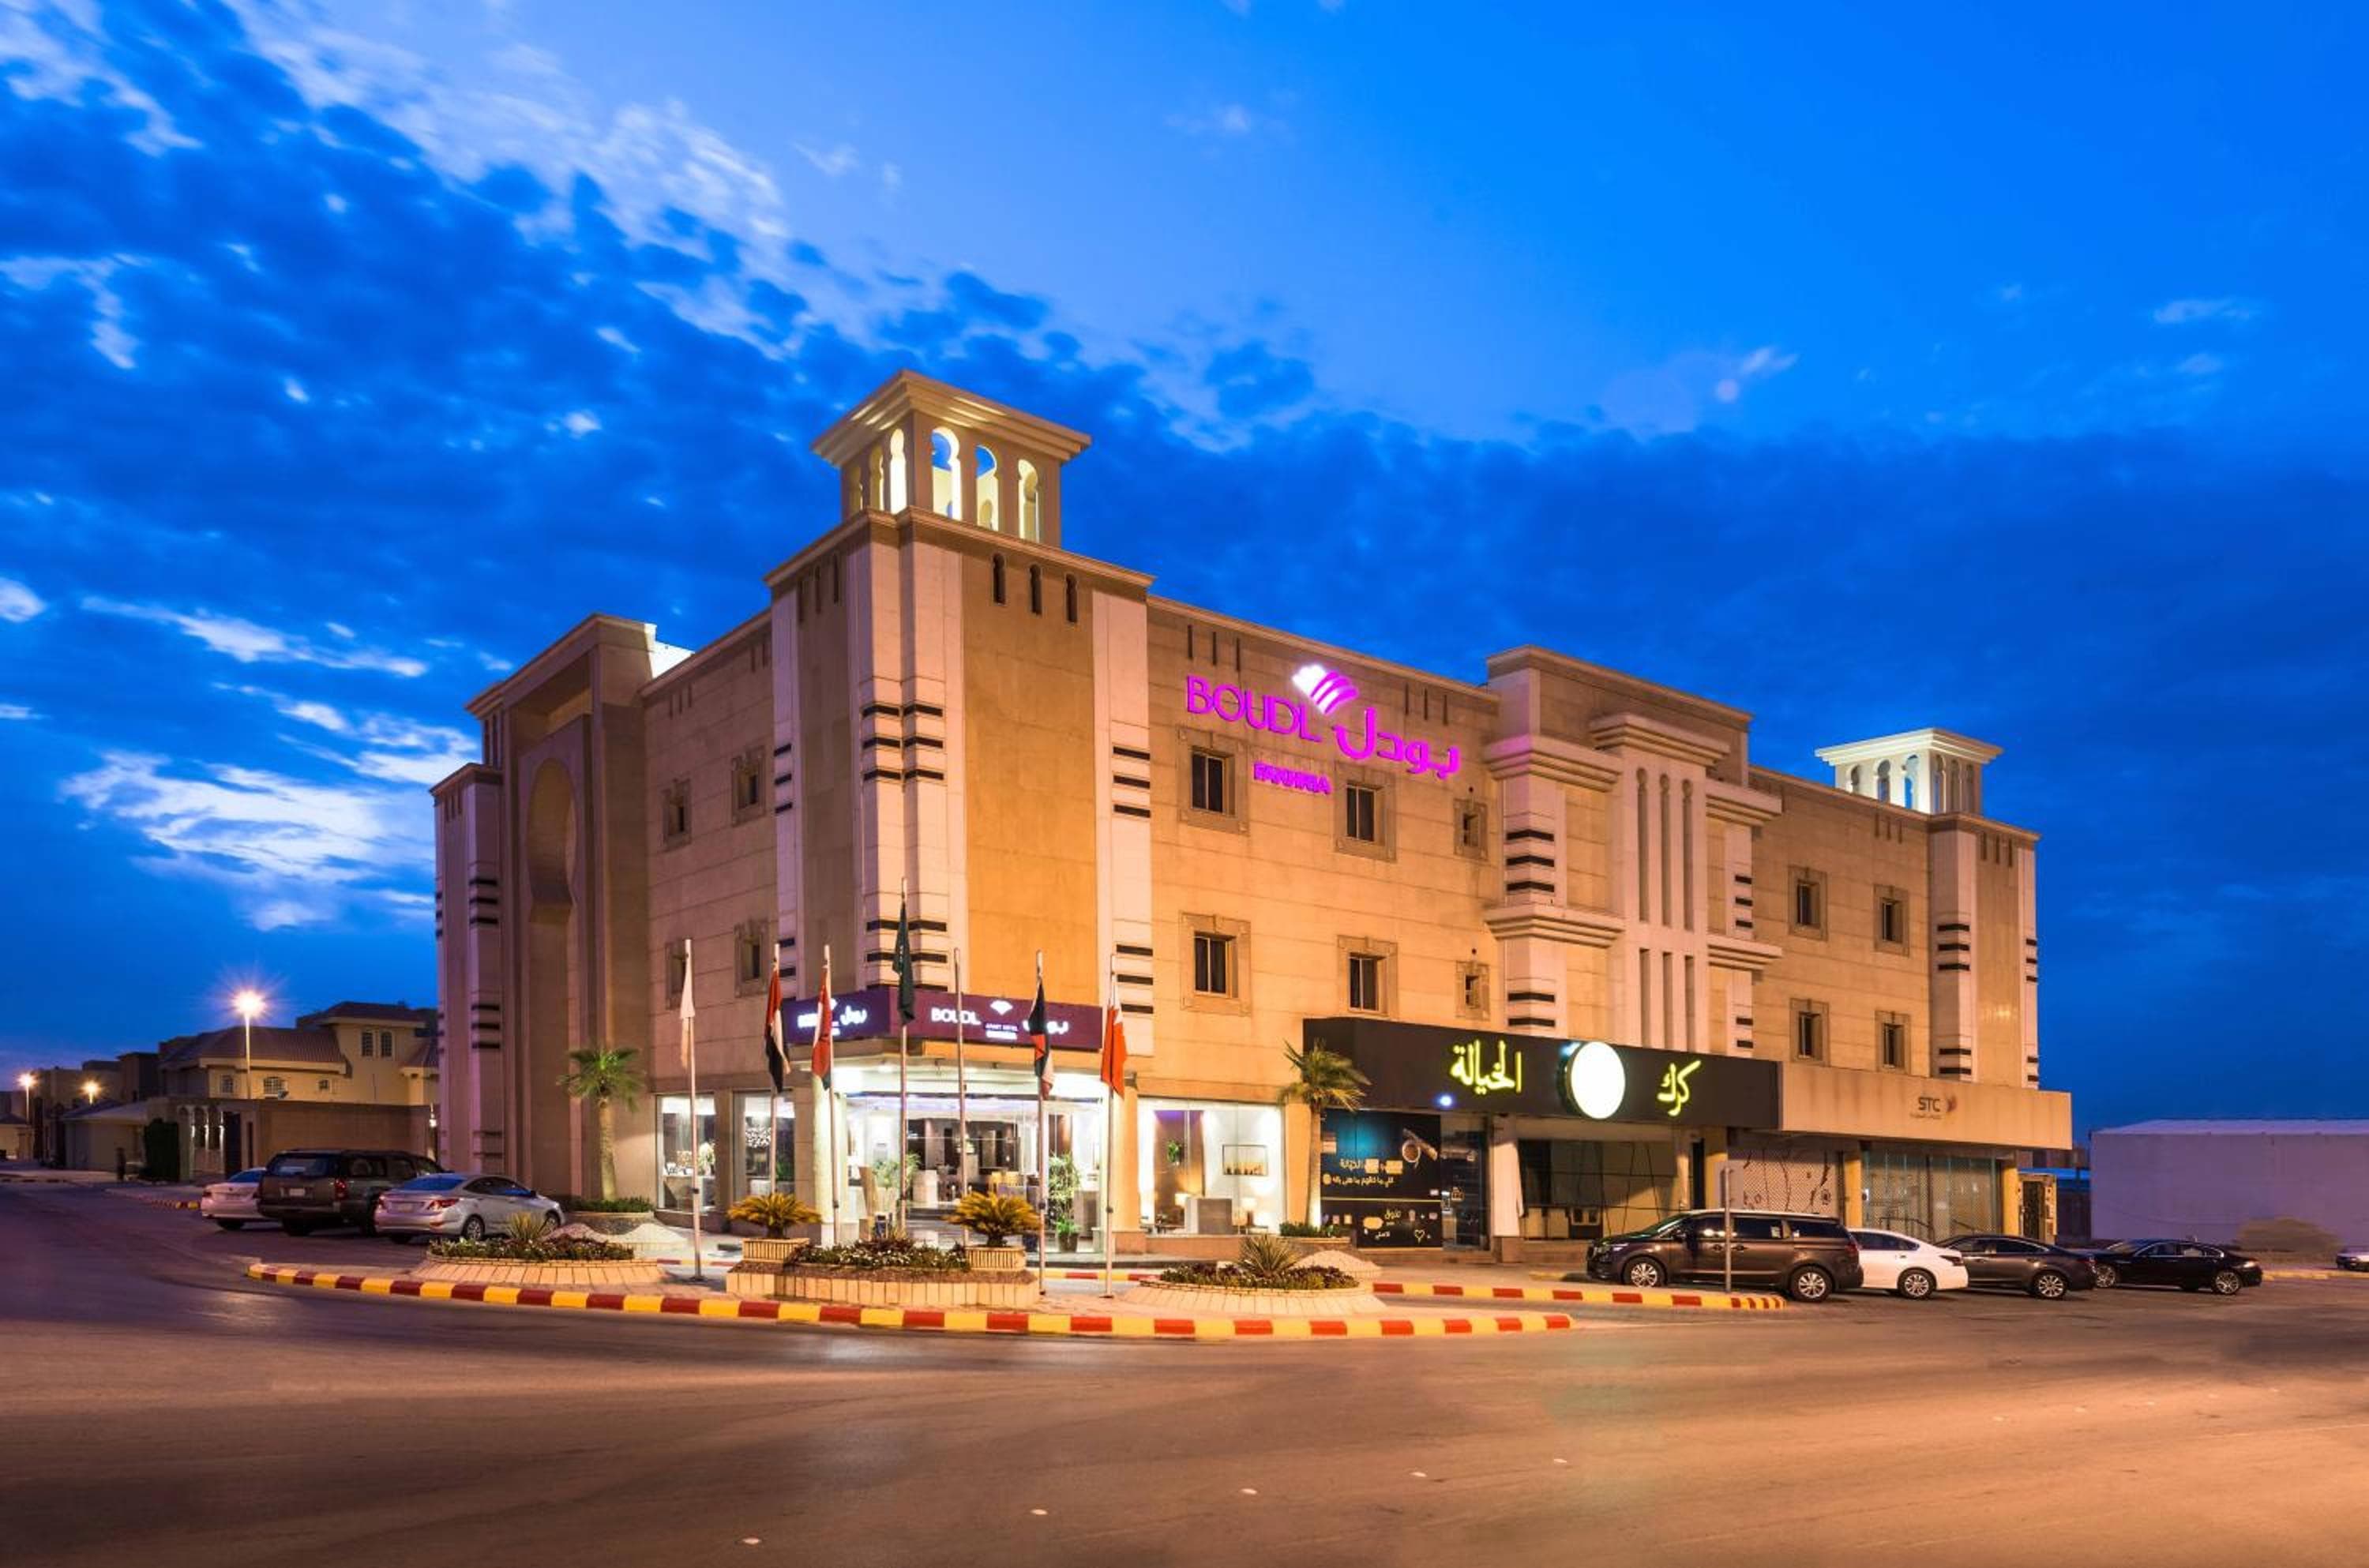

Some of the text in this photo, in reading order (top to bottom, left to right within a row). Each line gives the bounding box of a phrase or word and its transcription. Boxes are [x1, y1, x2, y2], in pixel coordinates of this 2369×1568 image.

[1186, 674, 1323, 743] BOUDL
[1331, 706, 1461, 780] بودل
[1450, 1038, 1702, 1116] كرك الخيالة
[1917, 1096, 1941, 1112] STC
